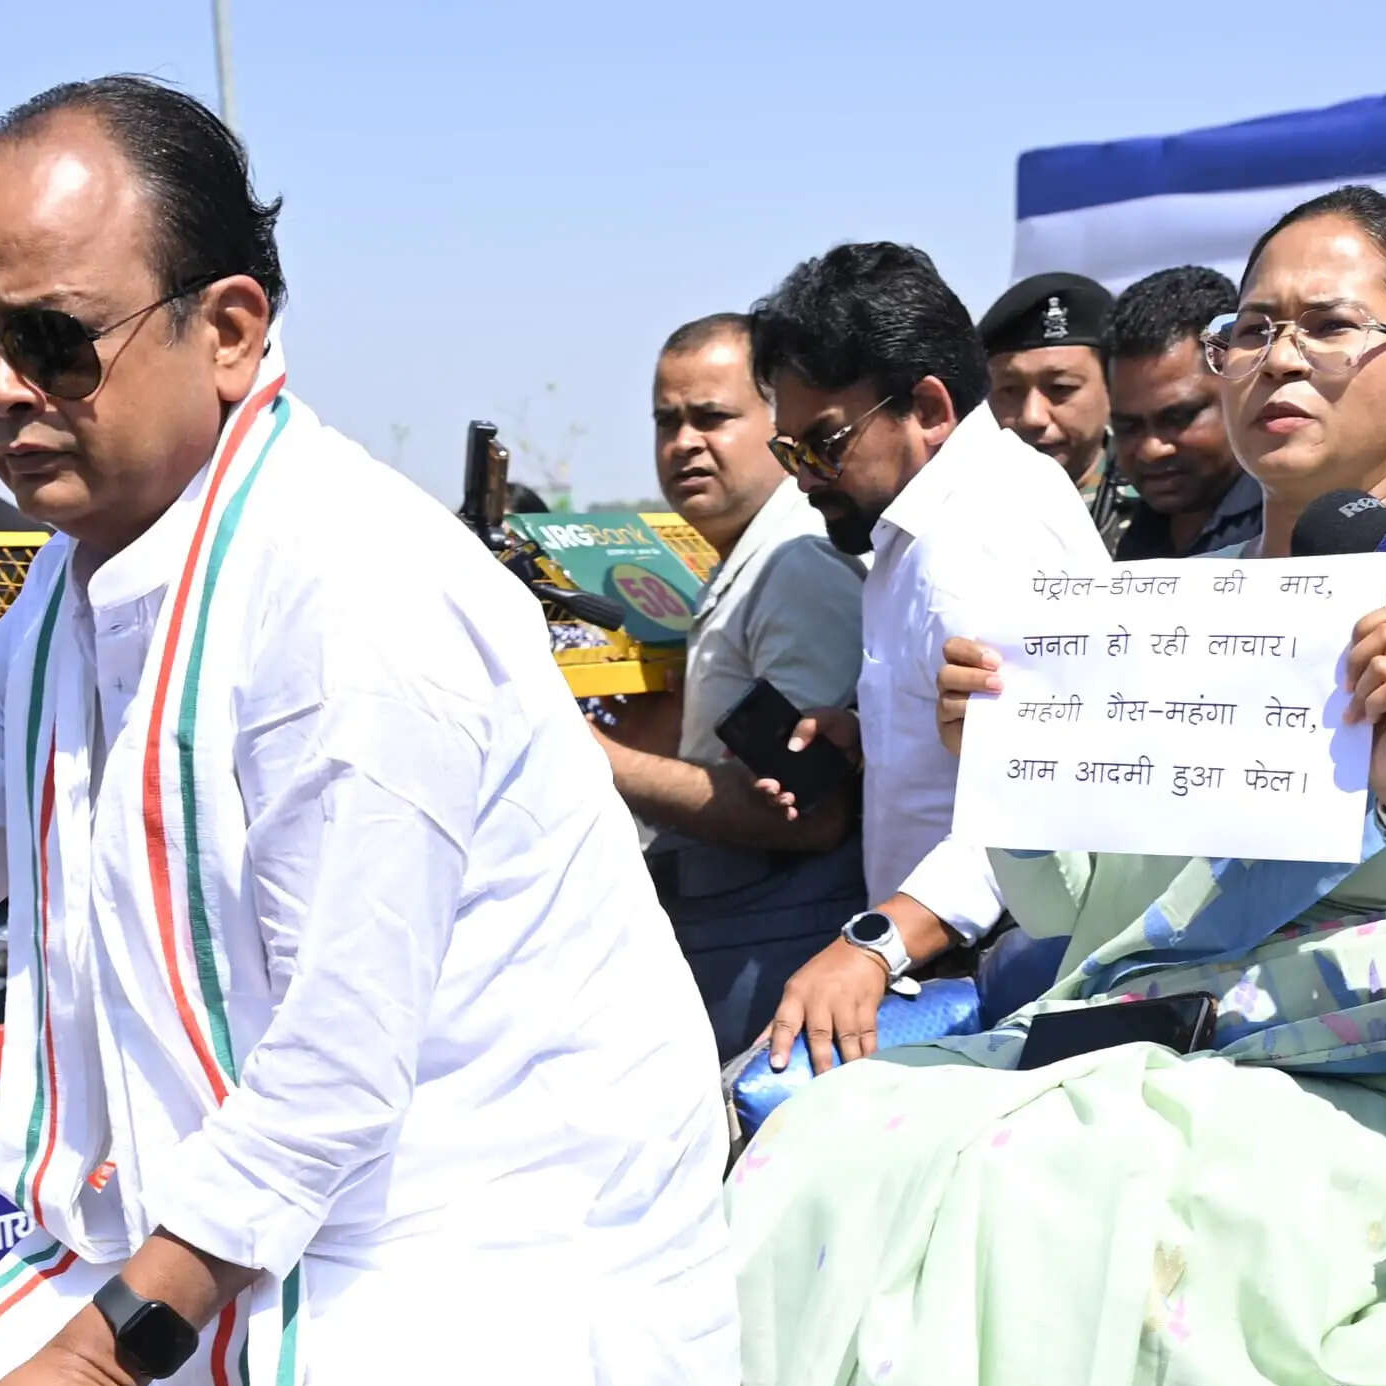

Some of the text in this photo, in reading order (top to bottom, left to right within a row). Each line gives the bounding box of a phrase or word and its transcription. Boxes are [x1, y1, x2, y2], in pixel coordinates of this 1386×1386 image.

[617, 576, 687, 619] 58
[1032, 568, 1333, 602] पेट्रोल-डीजल की मार,
[1023, 625, 1297, 659] जनता हो रही लाचार।
[1017, 692, 1318, 734] महंगी गैस-महंगा तेल,
[1007, 754, 1308, 797] आम आदमी हुआ फेल।
